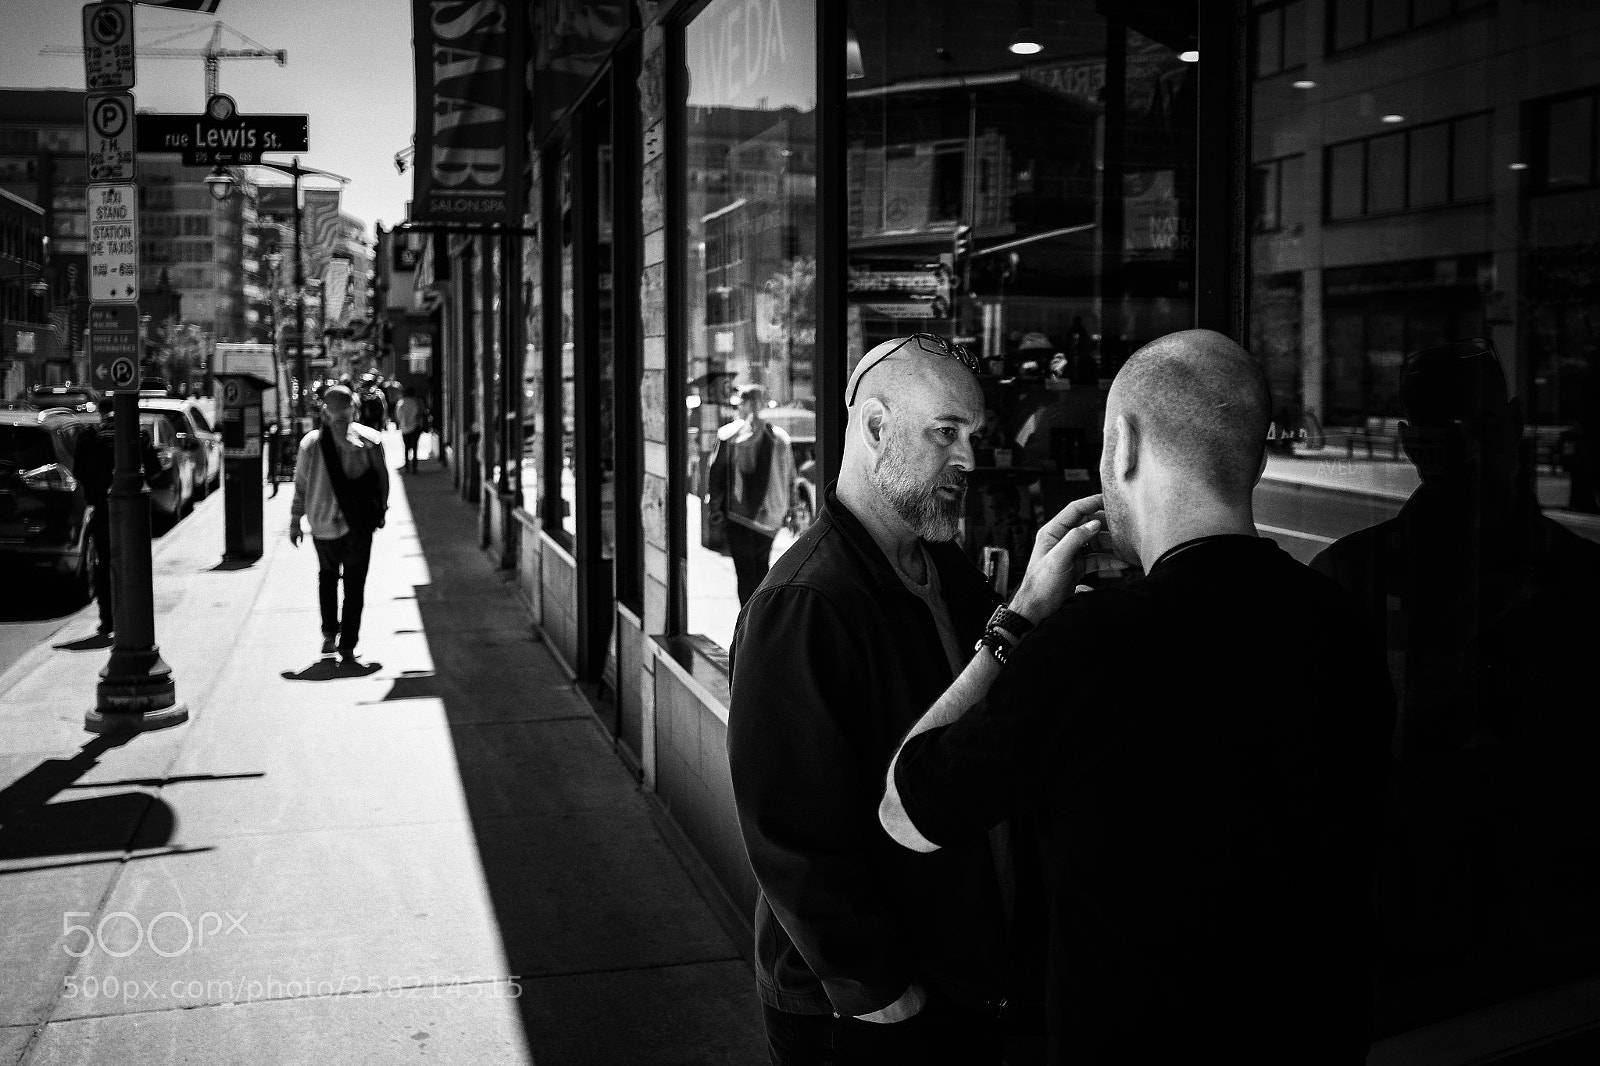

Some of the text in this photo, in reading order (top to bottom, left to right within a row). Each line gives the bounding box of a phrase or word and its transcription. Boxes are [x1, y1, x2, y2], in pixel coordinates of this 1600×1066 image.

[165, 121, 283, 149] rue Lewis St.
[102, 189, 123, 205] TAXI
[95, 205, 128, 220] STAND
[92, 224, 132, 241] STATION
[90, 240, 134, 256] DE TAXIS
